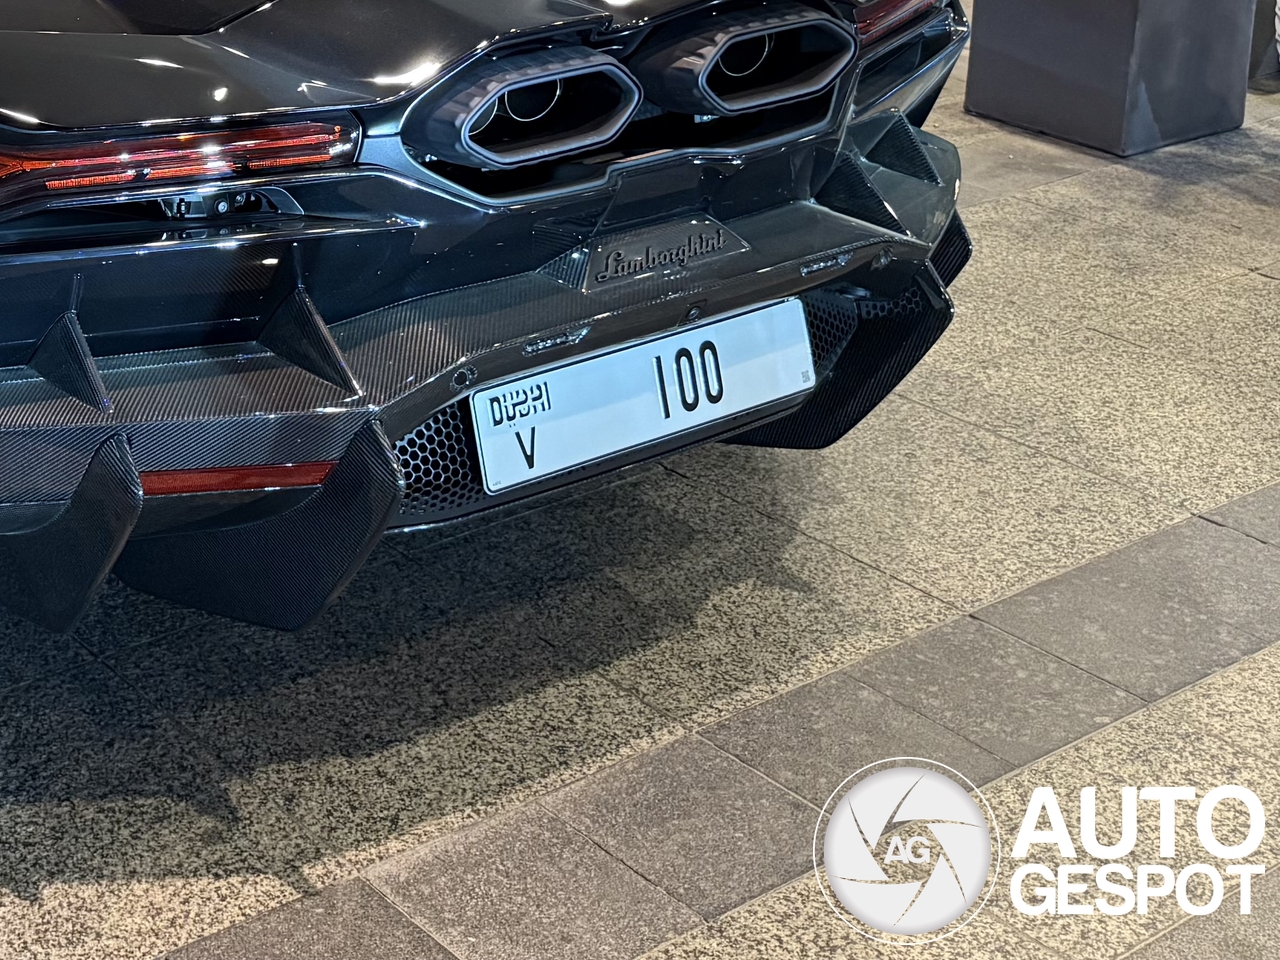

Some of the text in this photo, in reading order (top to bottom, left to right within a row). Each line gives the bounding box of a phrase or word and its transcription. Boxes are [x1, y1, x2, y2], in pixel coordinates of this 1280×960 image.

[595, 229, 728, 282] Lamborghini
[652, 340, 724, 420] 100
[515, 426, 535, 469] V
